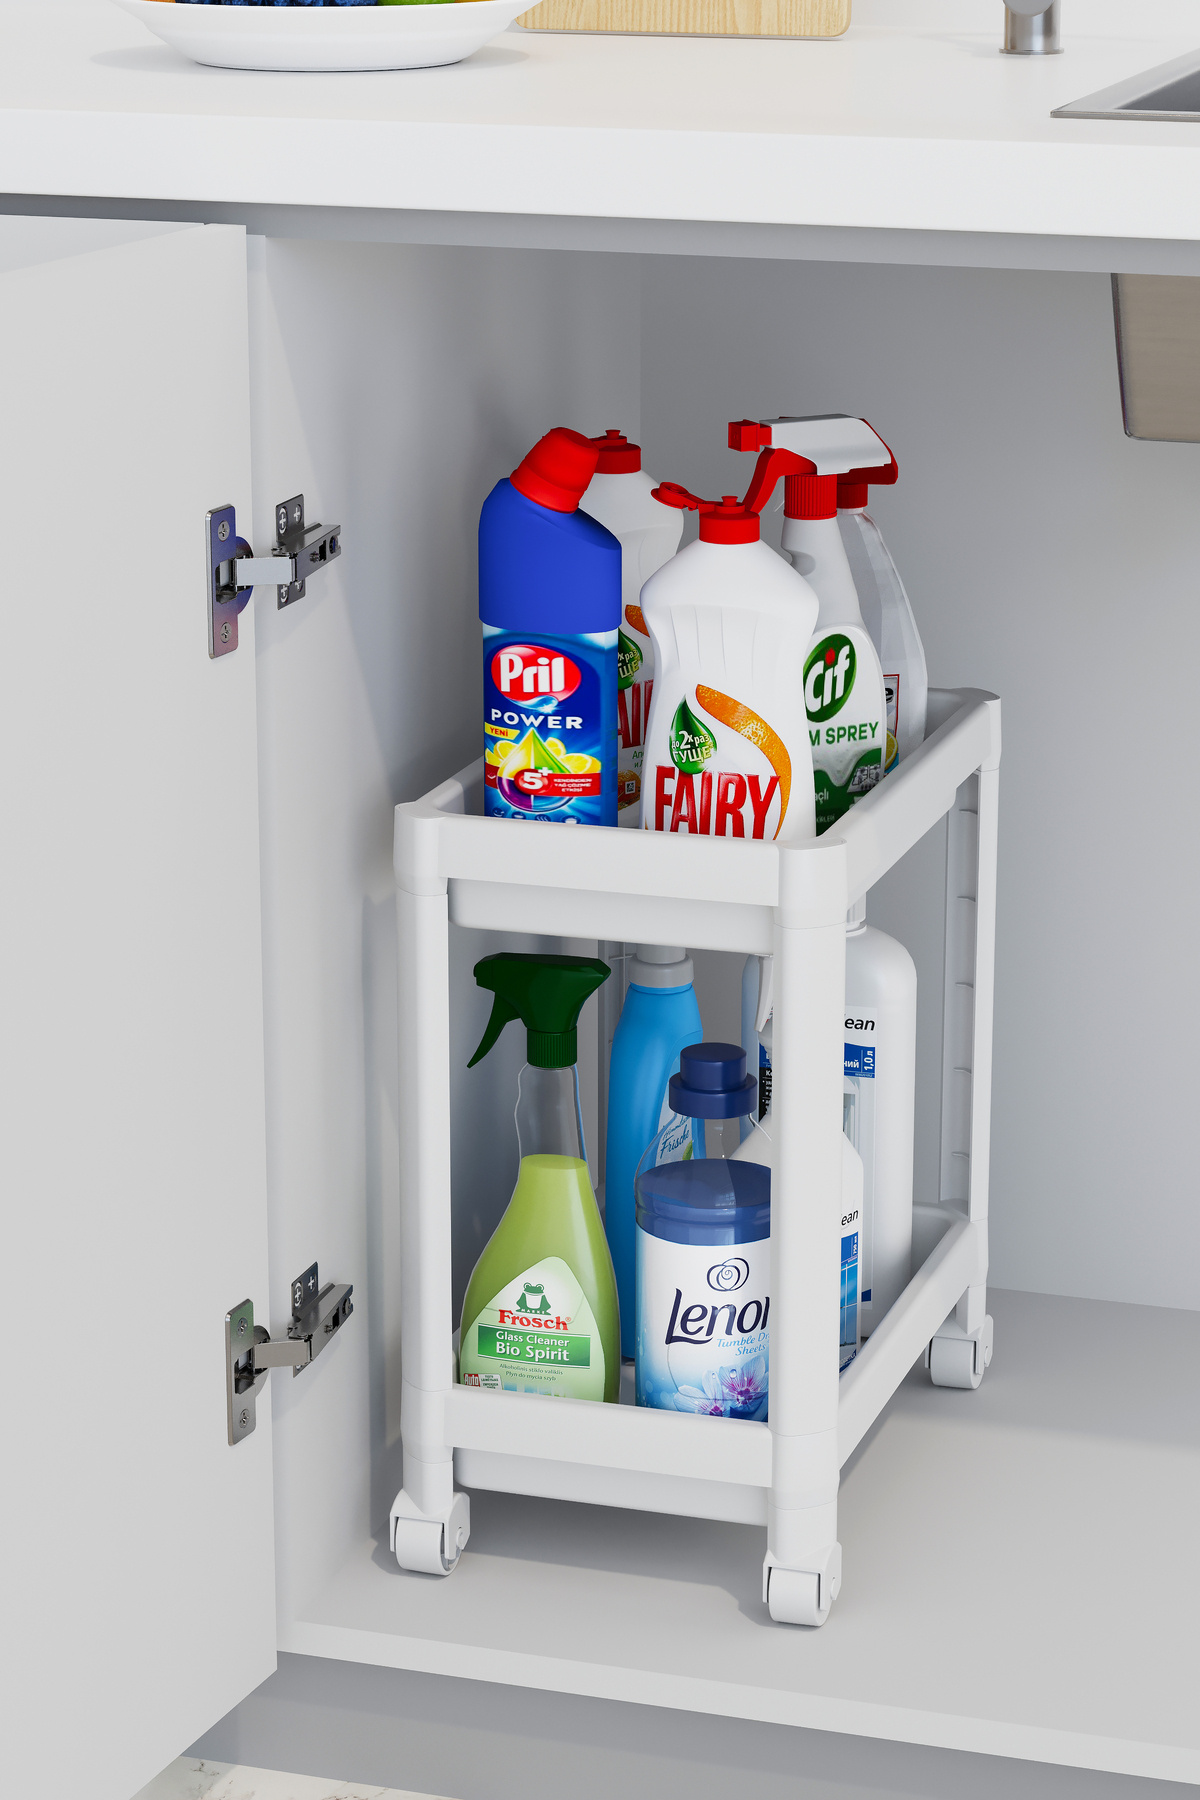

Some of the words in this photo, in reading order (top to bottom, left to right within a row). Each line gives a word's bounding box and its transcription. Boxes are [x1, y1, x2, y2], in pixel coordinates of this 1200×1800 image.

[500, 654, 565, 692] Pril
[805, 645, 850, 713] Cif
[491, 708, 583, 729] POWER
[490, 726, 508, 737] YENİ
[694, 734, 710, 747] раз
[826, 721, 879, 744] SPREY
[655, 765, 781, 839] FAIRY
[844, 1018, 875, 1031] ean
[841, 1210, 859, 1226] ean
[498, 1309, 568, 1330] Frosch
[496, 1331, 523, 1342] Glass
[526, 1335, 569, 1347] Cleaner
[717, 1335, 755, 1347] Tumble
[758, 1332, 769, 1343] Dr
[496, 1342, 520, 1356] Bio
[526, 1346, 570, 1362] Spirit
[735, 1344, 766, 1356] Sheets
